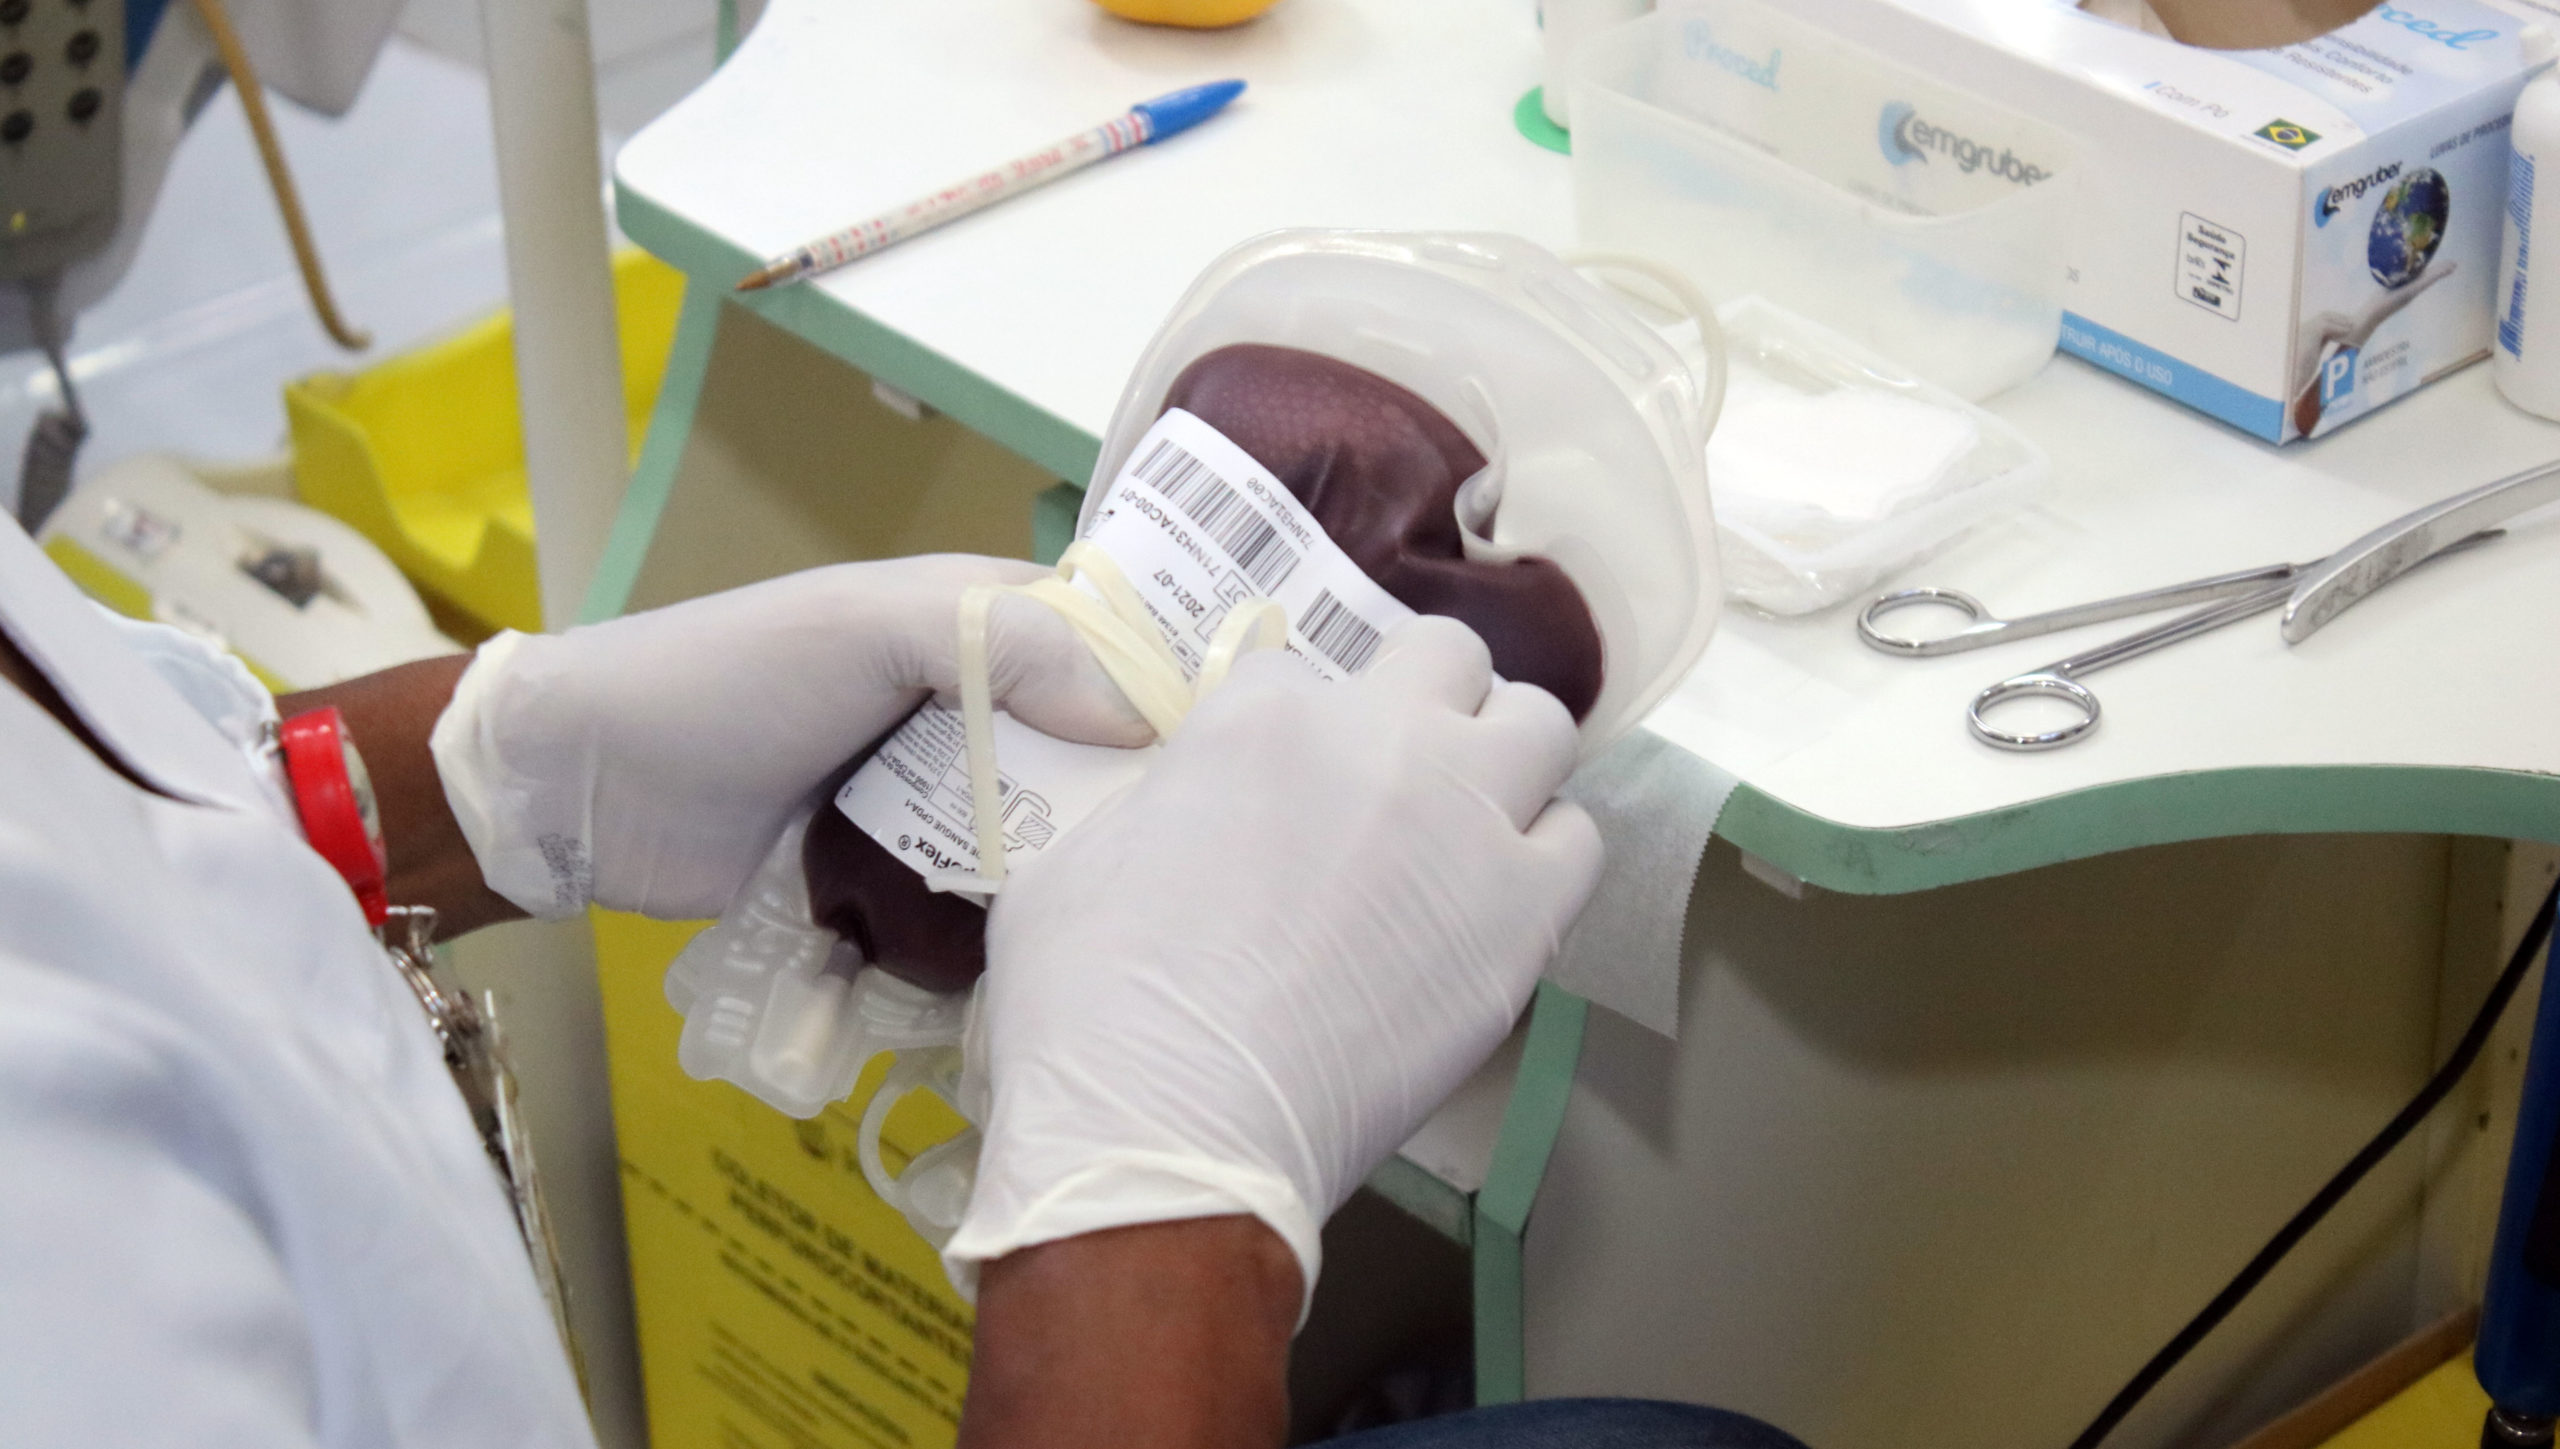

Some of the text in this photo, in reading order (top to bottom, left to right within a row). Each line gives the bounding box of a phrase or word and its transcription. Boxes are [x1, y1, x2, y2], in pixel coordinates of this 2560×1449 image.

[2155, 85, 2201, 107] Com
[2146, 365, 2173, 386] USO
[2325, 355, 2349, 399] P
[1119, 487, 1221, 577] 71NH31AC00-01
[1246, 477, 1316, 551] 71NH31AC00
[1153, 567, 1206, 620] 2021-07
[903, 797, 935, 825] CPDA-1
[932, 820, 970, 850] SANGUE
